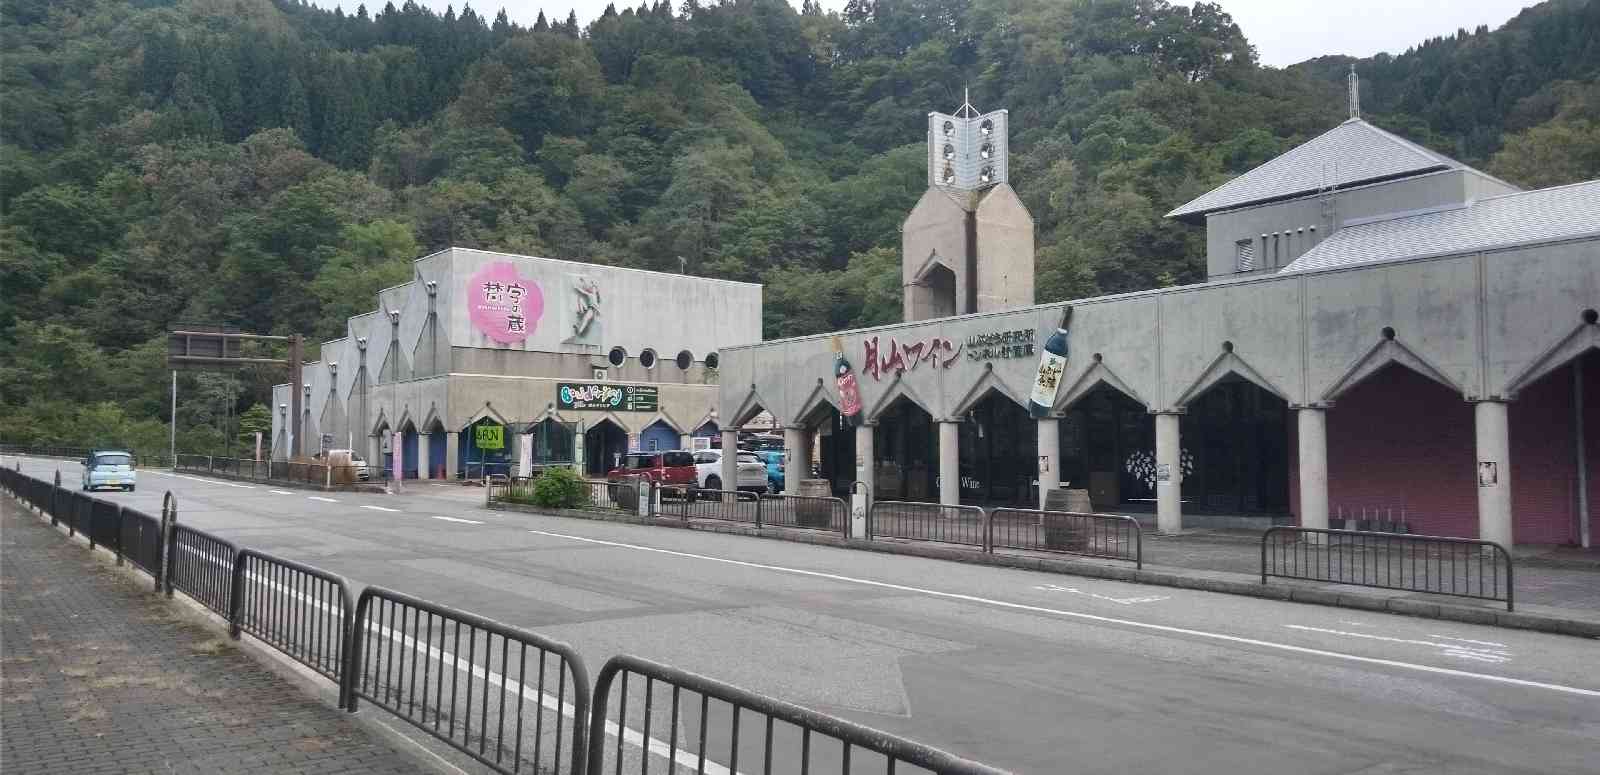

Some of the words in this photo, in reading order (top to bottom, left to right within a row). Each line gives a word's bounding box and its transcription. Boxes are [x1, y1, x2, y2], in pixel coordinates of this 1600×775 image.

[862, 336, 963, 381] 月山ワイン
[961, 477, 980, 488] Wine
